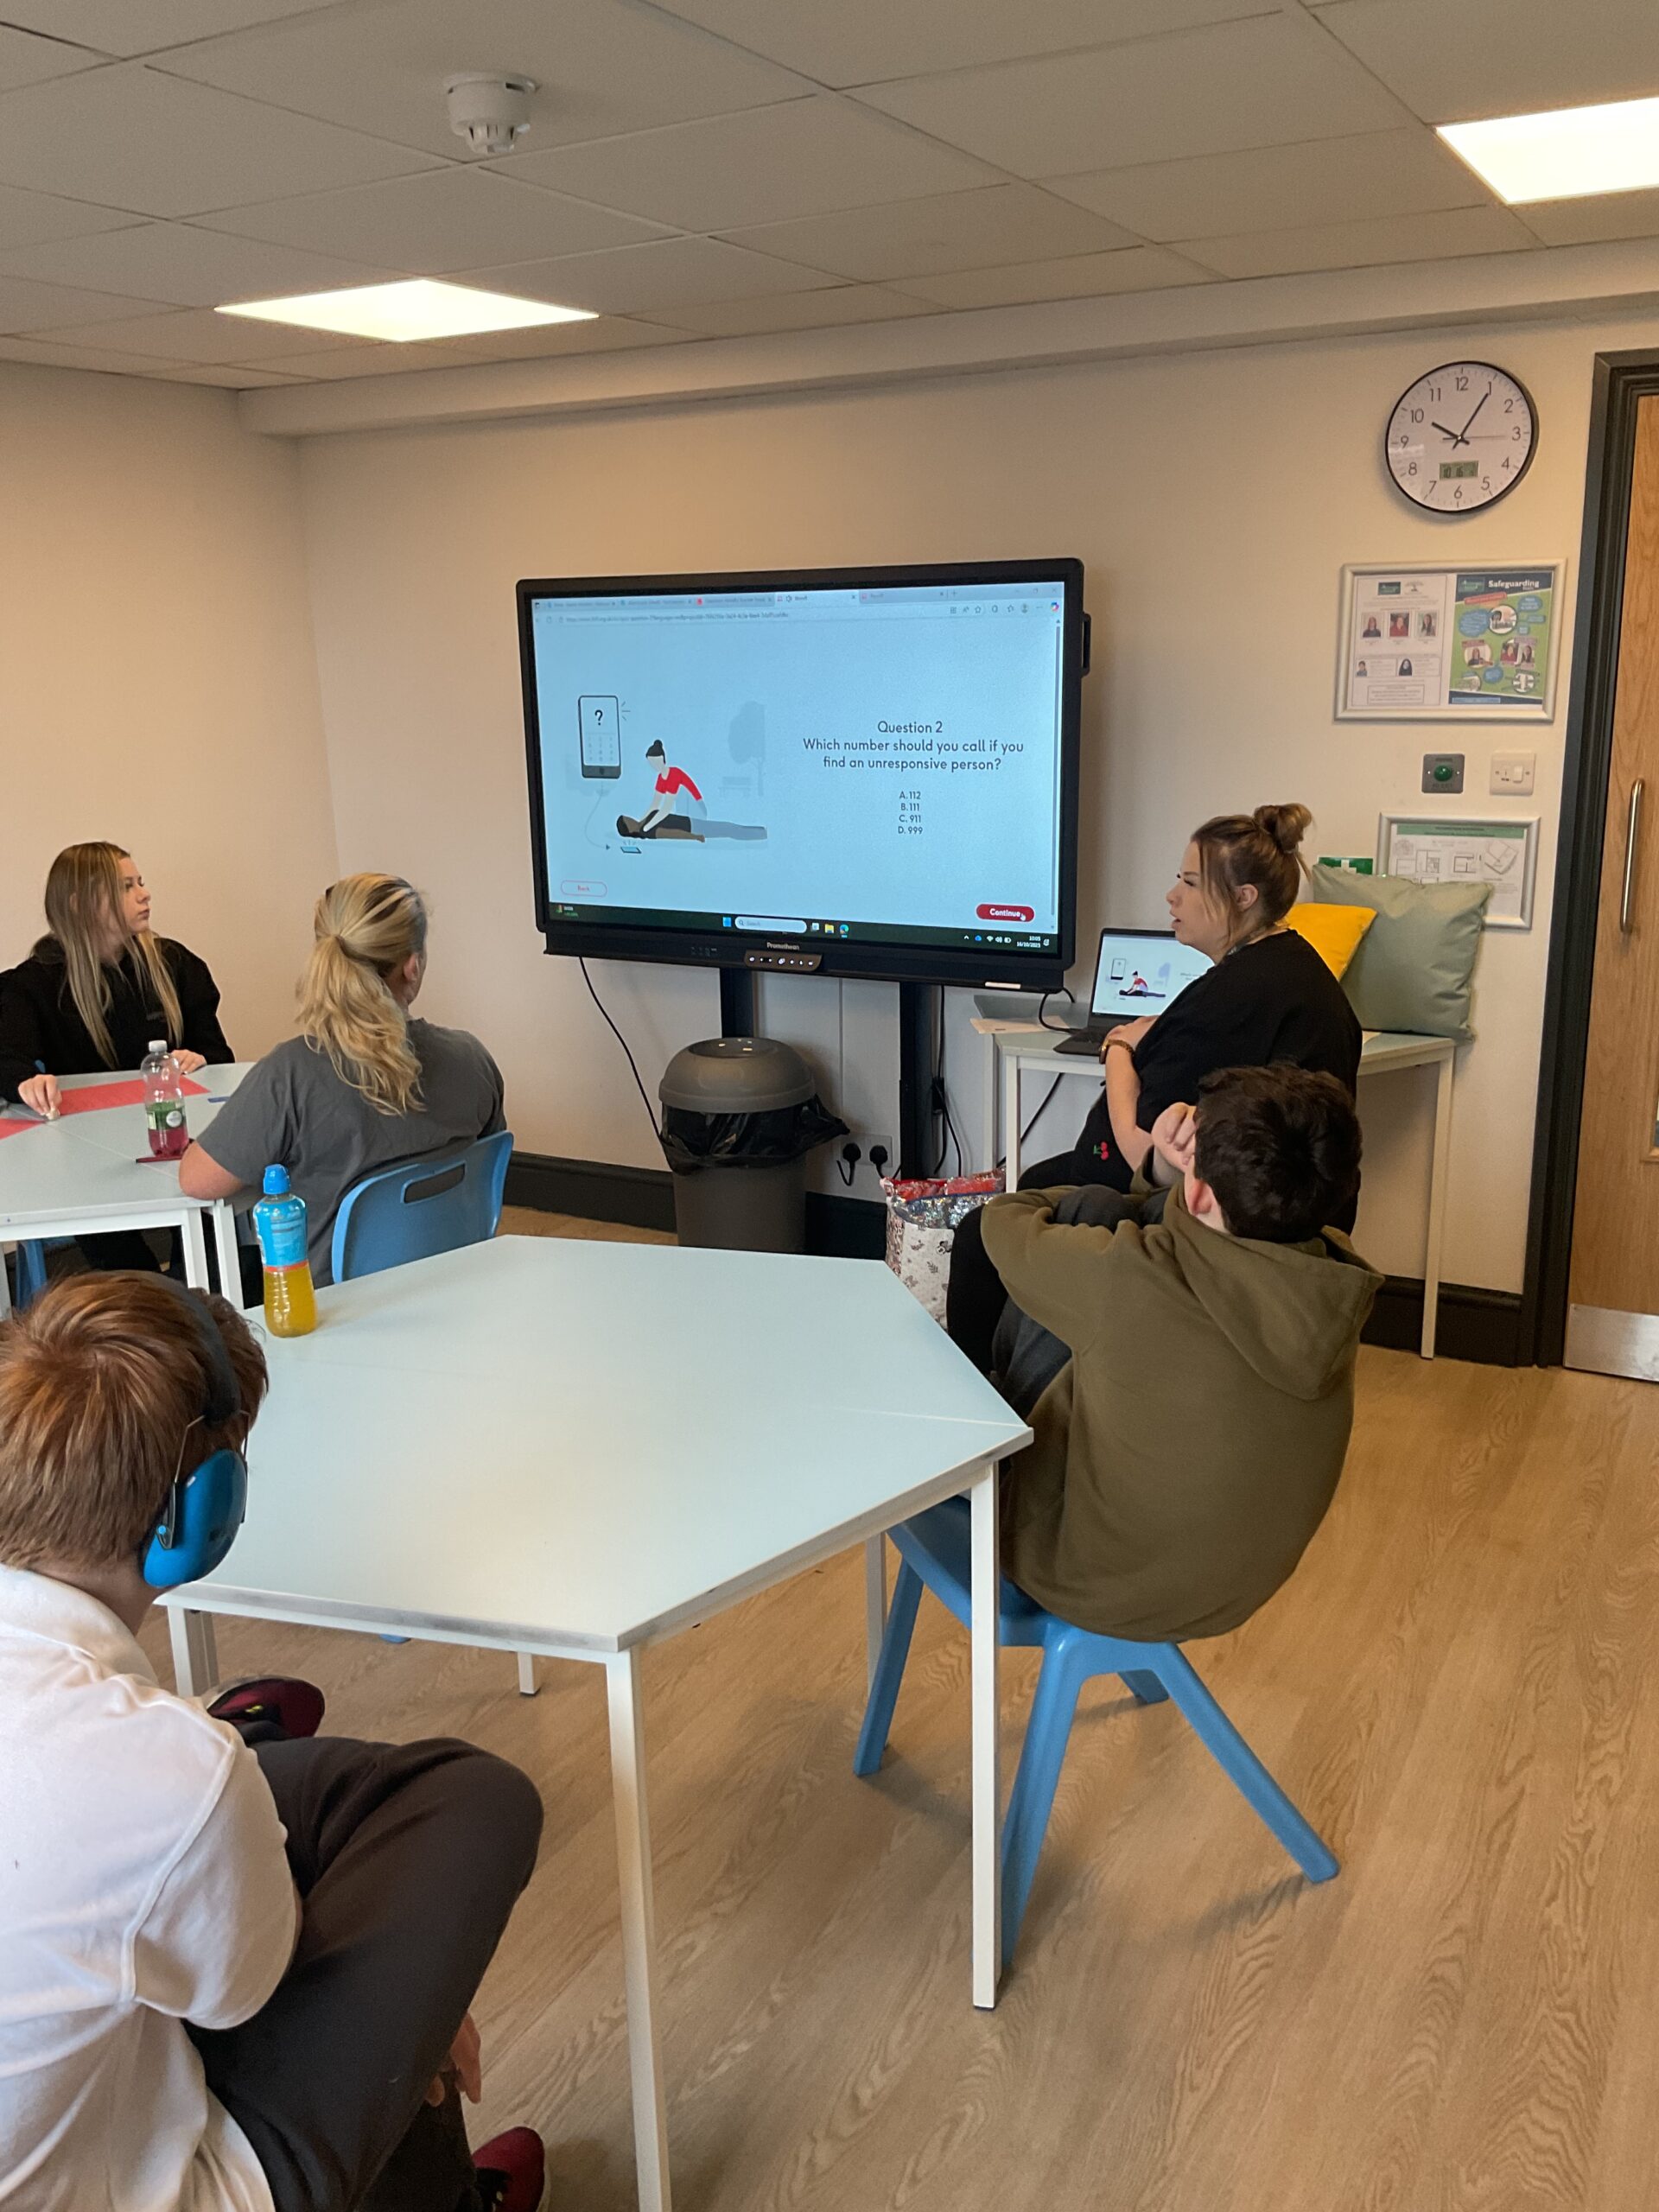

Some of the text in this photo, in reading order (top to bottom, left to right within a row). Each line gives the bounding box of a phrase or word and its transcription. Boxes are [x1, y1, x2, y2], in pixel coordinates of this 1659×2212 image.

[1455, 377, 1469, 391] 12
[1430, 388, 1441, 402] 11
[1504, 398, 1513, 413] 2
[1411, 409, 1424, 423] 10
[1512, 426, 1521, 441] 3
[1401, 435, 1409, 448] 9
[1408, 462, 1417, 476] 8
[1501, 457, 1510, 470] 4
[1429, 480, 1437, 494] 7
[1481, 477, 1491, 491] 5
[1453, 486, 1463, 499] 6
[1489, 580, 1540, 588] Safeguarding
[594, 709, 603, 726] ?
[877, 721, 943, 734] Question 2
[803, 738, 1024, 755] Which number should you call if you
[823, 756, 1001, 772] find an unresponsive person?
[909, 791, 921, 800] 112
[900, 803, 920, 811] B. 111
[909, 814, 921, 823] 911
[907, 826, 923, 835] 999
[989, 908, 1020, 918] Continue
[766, 942, 800, 951] Promethean
